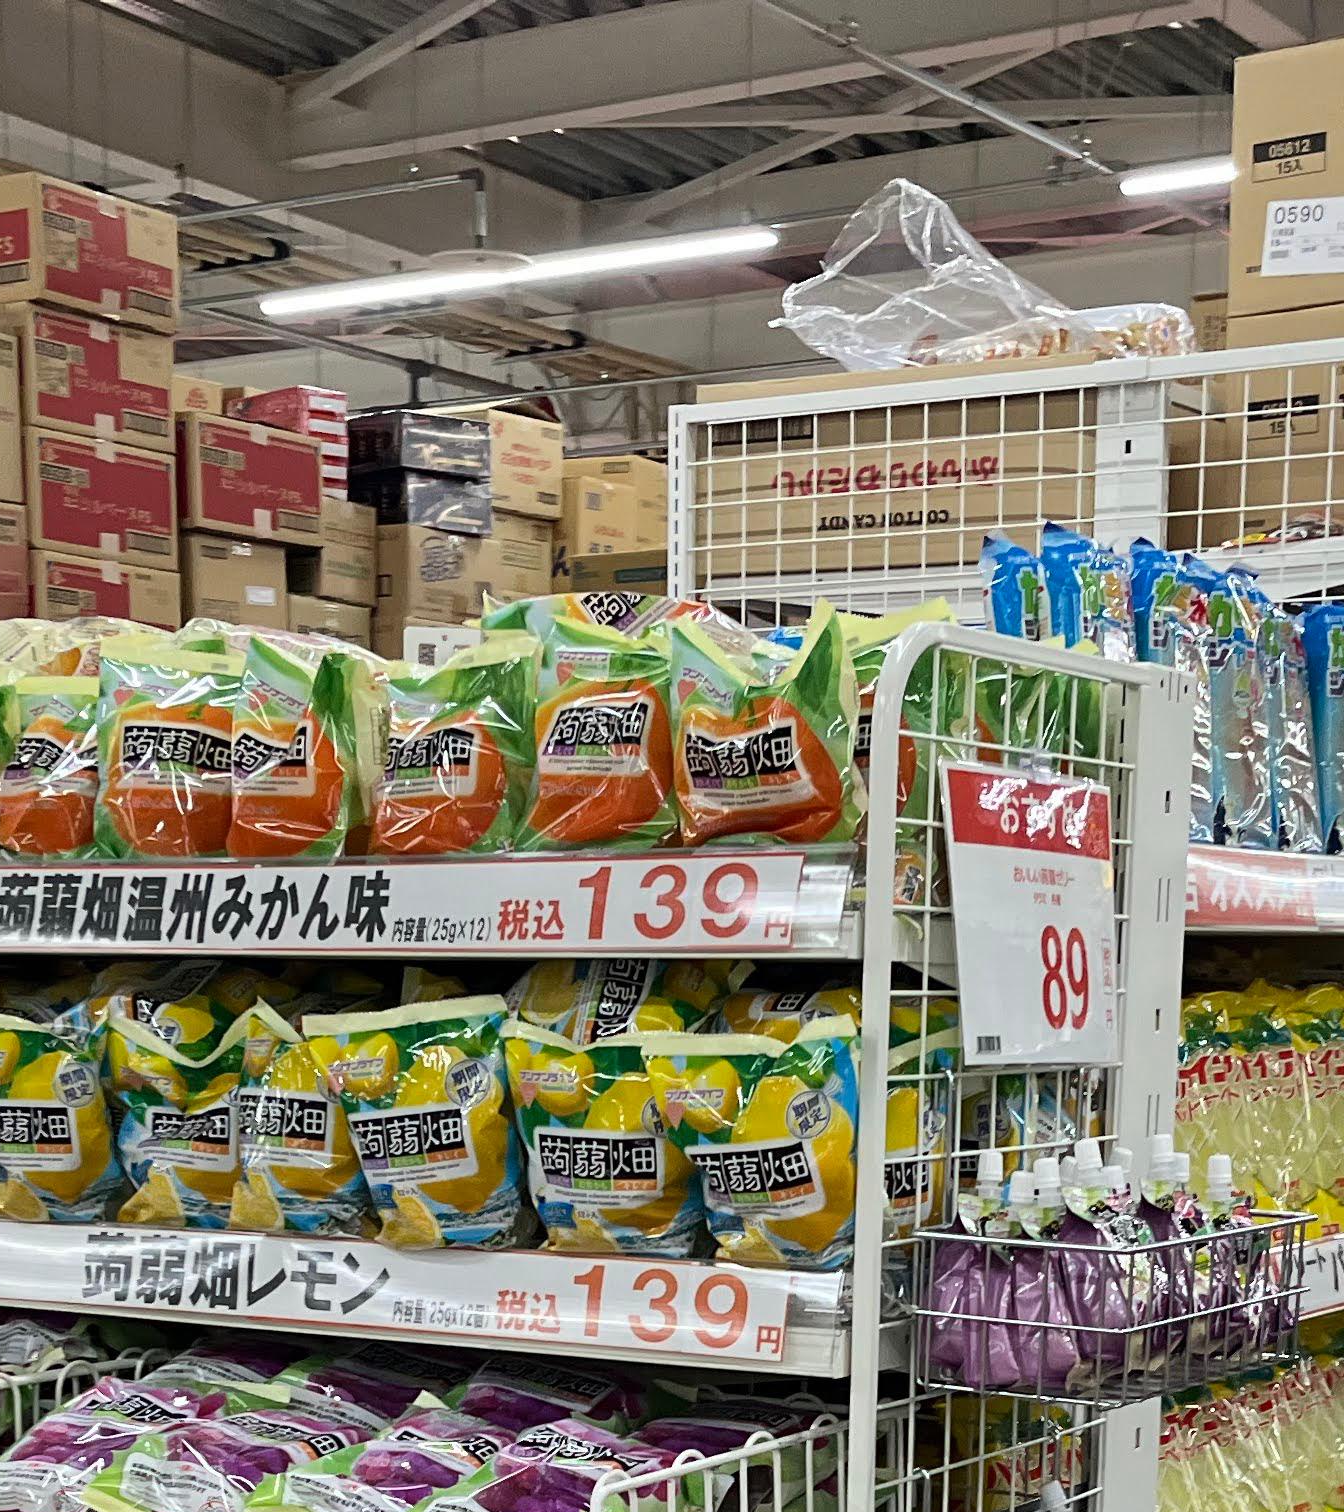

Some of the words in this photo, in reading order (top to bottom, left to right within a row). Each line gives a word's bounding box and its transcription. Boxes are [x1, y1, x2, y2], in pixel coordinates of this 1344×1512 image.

[1273, 204, 1325, 225] 0590
[685, 725, 797, 778] 蒟蒻畑
[497, 898, 566, 943] 税込
[577, 862, 761, 941] 139
[1040, 924, 1091, 1031] 89
[354, 1113, 465, 1161] 蒟蒻畑
[540, 1133, 657, 1179] 蒟蒻畑
[693, 1147, 810, 1193] 蒟蒻畑
[82, 1230, 391, 1316] 蒟蒻畑レモン
[496, 1288, 562, 1335] 税込
[572, 1265, 750, 1350] 139
